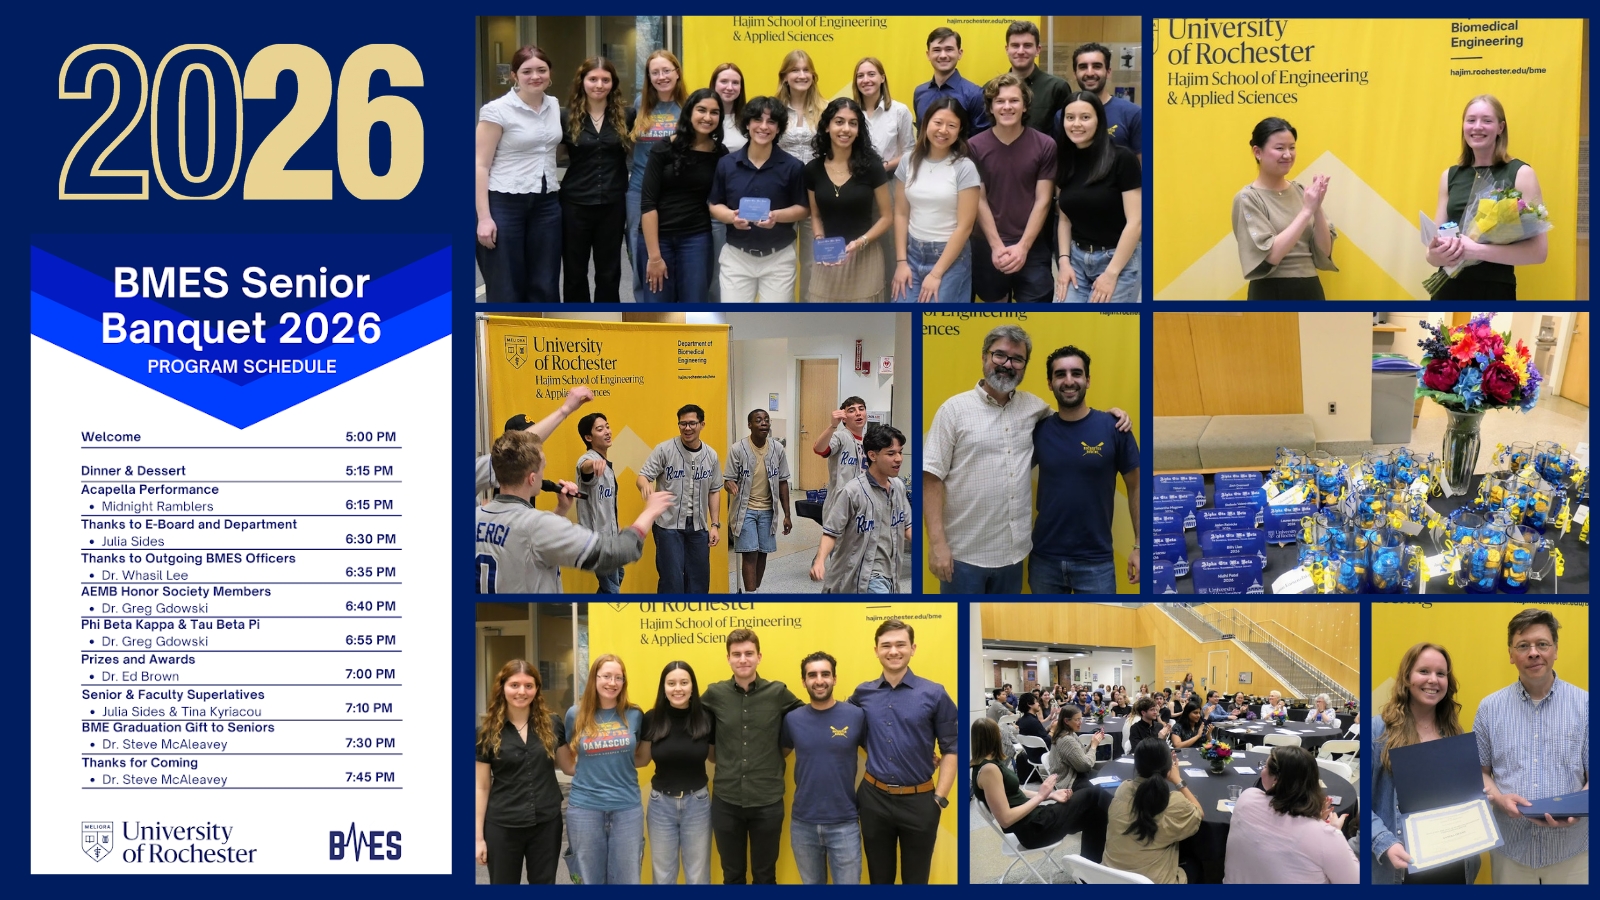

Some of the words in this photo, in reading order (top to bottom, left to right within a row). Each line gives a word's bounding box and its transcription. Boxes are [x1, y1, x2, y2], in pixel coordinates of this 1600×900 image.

[734, 16, 764, 28] Hajim
[768, 16, 803, 27] School
[806, 16, 817, 26] of
[820, 16, 887, 29] Engineering
[1169, 18, 1288, 41] University
[1451, 19, 1518, 33] Biomedical
[733, 31, 741, 41] &
[744, 31, 784, 43] Applied
[788, 31, 833, 41] Sciences
[1451, 35, 1524, 49] Engineering
[1168, 43, 1192, 65] of
[1196, 41, 1315, 65] Rochester
[1168, 72, 1209, 88] Hajim
[1212, 71, 1259, 86] School
[1261, 70, 1277, 85] of
[1279, 68, 1369, 88] Engineering
[1450, 67, 1547, 77] hajim.rochester.edu/bme
[1167, 92, 1178, 105] &
[1181, 91, 1234, 108] Applied
[1237, 90, 1298, 105] Sciences
[533, 337, 603, 356] University
[535, 355, 550, 370] of
[552, 355, 617, 370] Rochester
[535, 375, 561, 387] Hajim
[562, 375, 589, 385] School
[591, 375, 599, 385] of
[600, 375, 644, 387] Engineering
[536, 389, 543, 399] &
[640, 618, 673, 631] Hajim
[675, 617, 713, 629] School
[715, 616, 728, 629] of
[729, 615, 802, 629] Engineering
[866, 613, 943, 622] hajim.rochester.edu/bme
[640, 634, 650, 645] &
[651, 632, 694, 647] Applied
[583, 738, 630, 750] DAMASCUS
